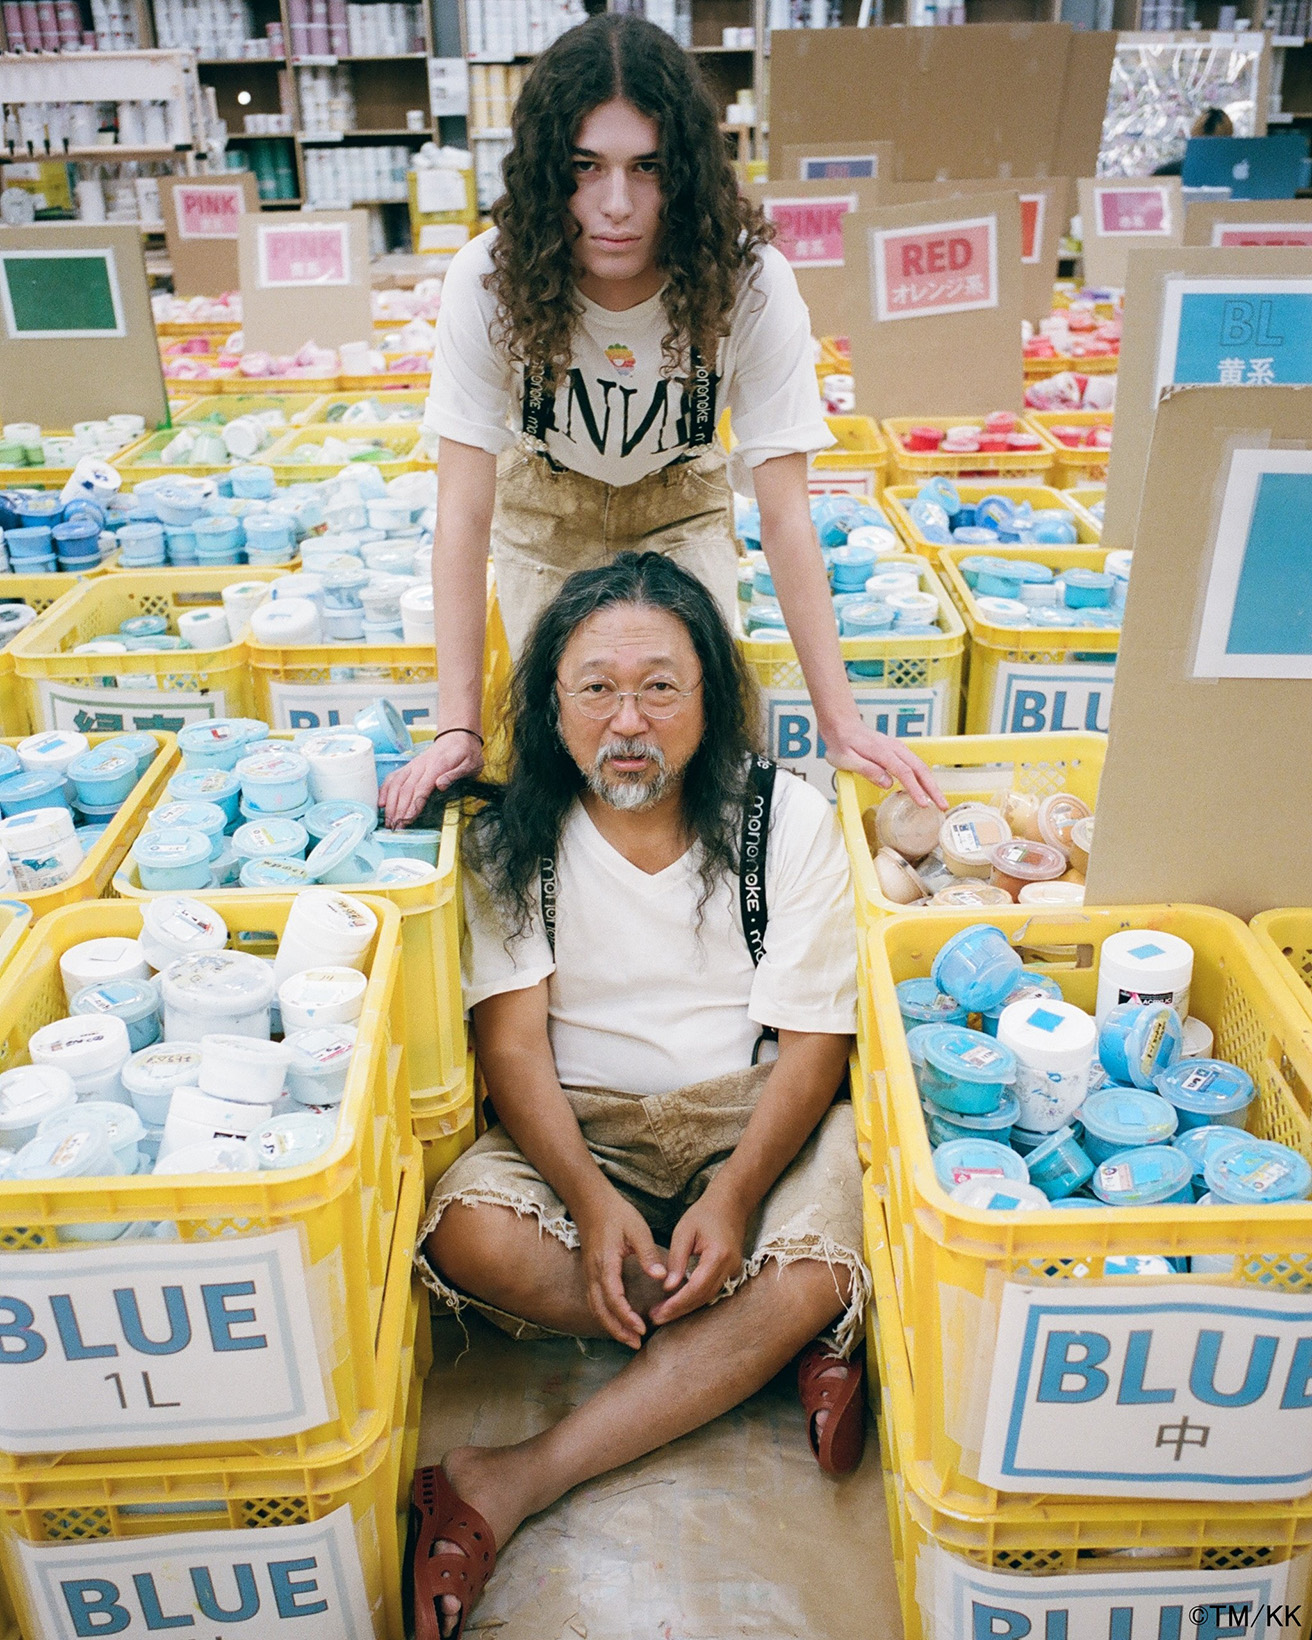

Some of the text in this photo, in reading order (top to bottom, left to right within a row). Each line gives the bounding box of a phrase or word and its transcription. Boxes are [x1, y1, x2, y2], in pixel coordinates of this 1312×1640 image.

[184, 194, 238, 215] PINK
[778, 209, 843, 237] PINK
[901, 238, 973, 277] RED
[892, 273, 984, 304] オレンジ系
[1217, 356, 1275, 385] 黄系
[0, 1280, 269, 1364] BLUE
[104, 1370, 181, 1410] 1L
[1154, 1415, 1211, 1461] 中
[60, 1556, 329, 1638] BLUE
